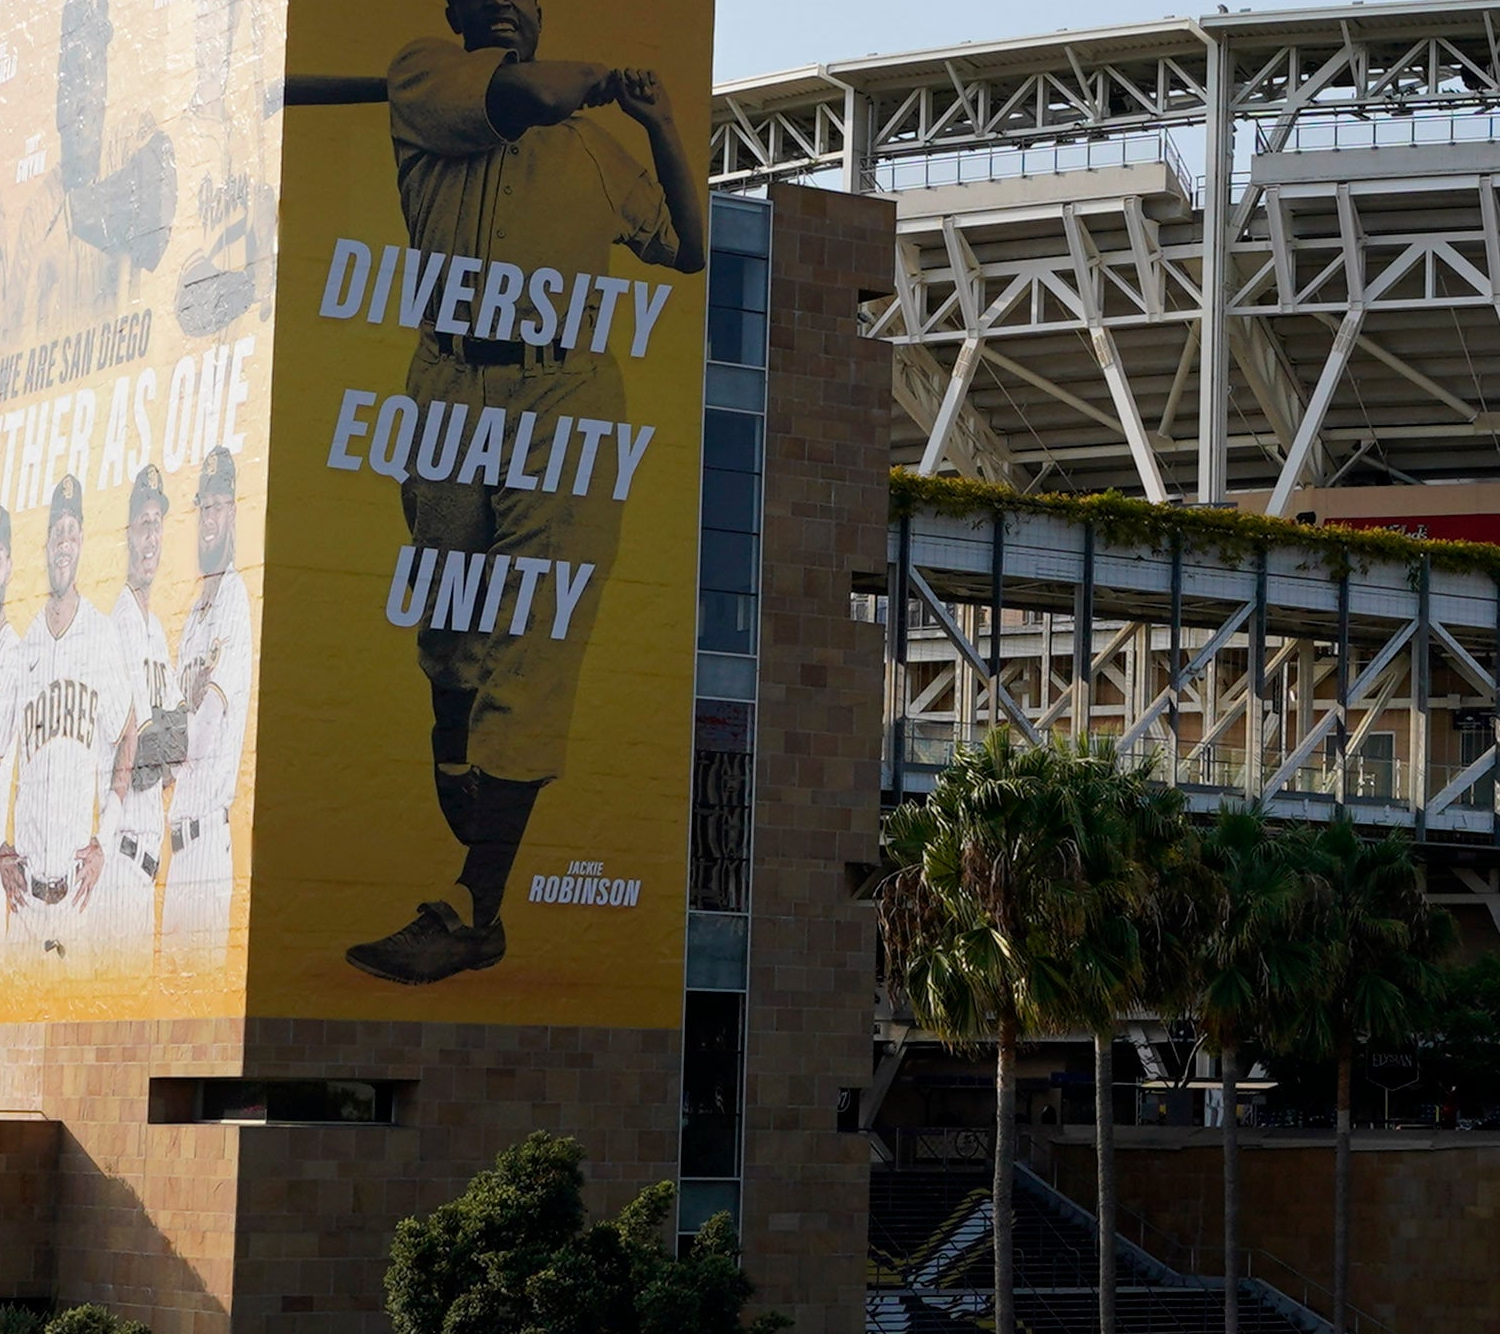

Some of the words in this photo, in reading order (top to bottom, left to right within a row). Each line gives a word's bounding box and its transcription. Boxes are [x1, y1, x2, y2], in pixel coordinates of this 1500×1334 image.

[318, 237, 673, 358] DIVERSITY
[22, 339, 59, 395] ARE
[58, 326, 98, 384] SAN
[96, 308, 153, 372] DIEGO
[97, 367, 157, 491] AS
[162, 335, 256, 474] ONE
[326, 388, 657, 502] EQUALITY
[385, 545, 596, 641] UNITY
[22, 677, 100, 765] PADRES
[528, 875, 641, 907] ROBINSON
[567, 860, 604, 876] JACKIE
[1372, 1052, 1412, 1067] ELYSIAN
